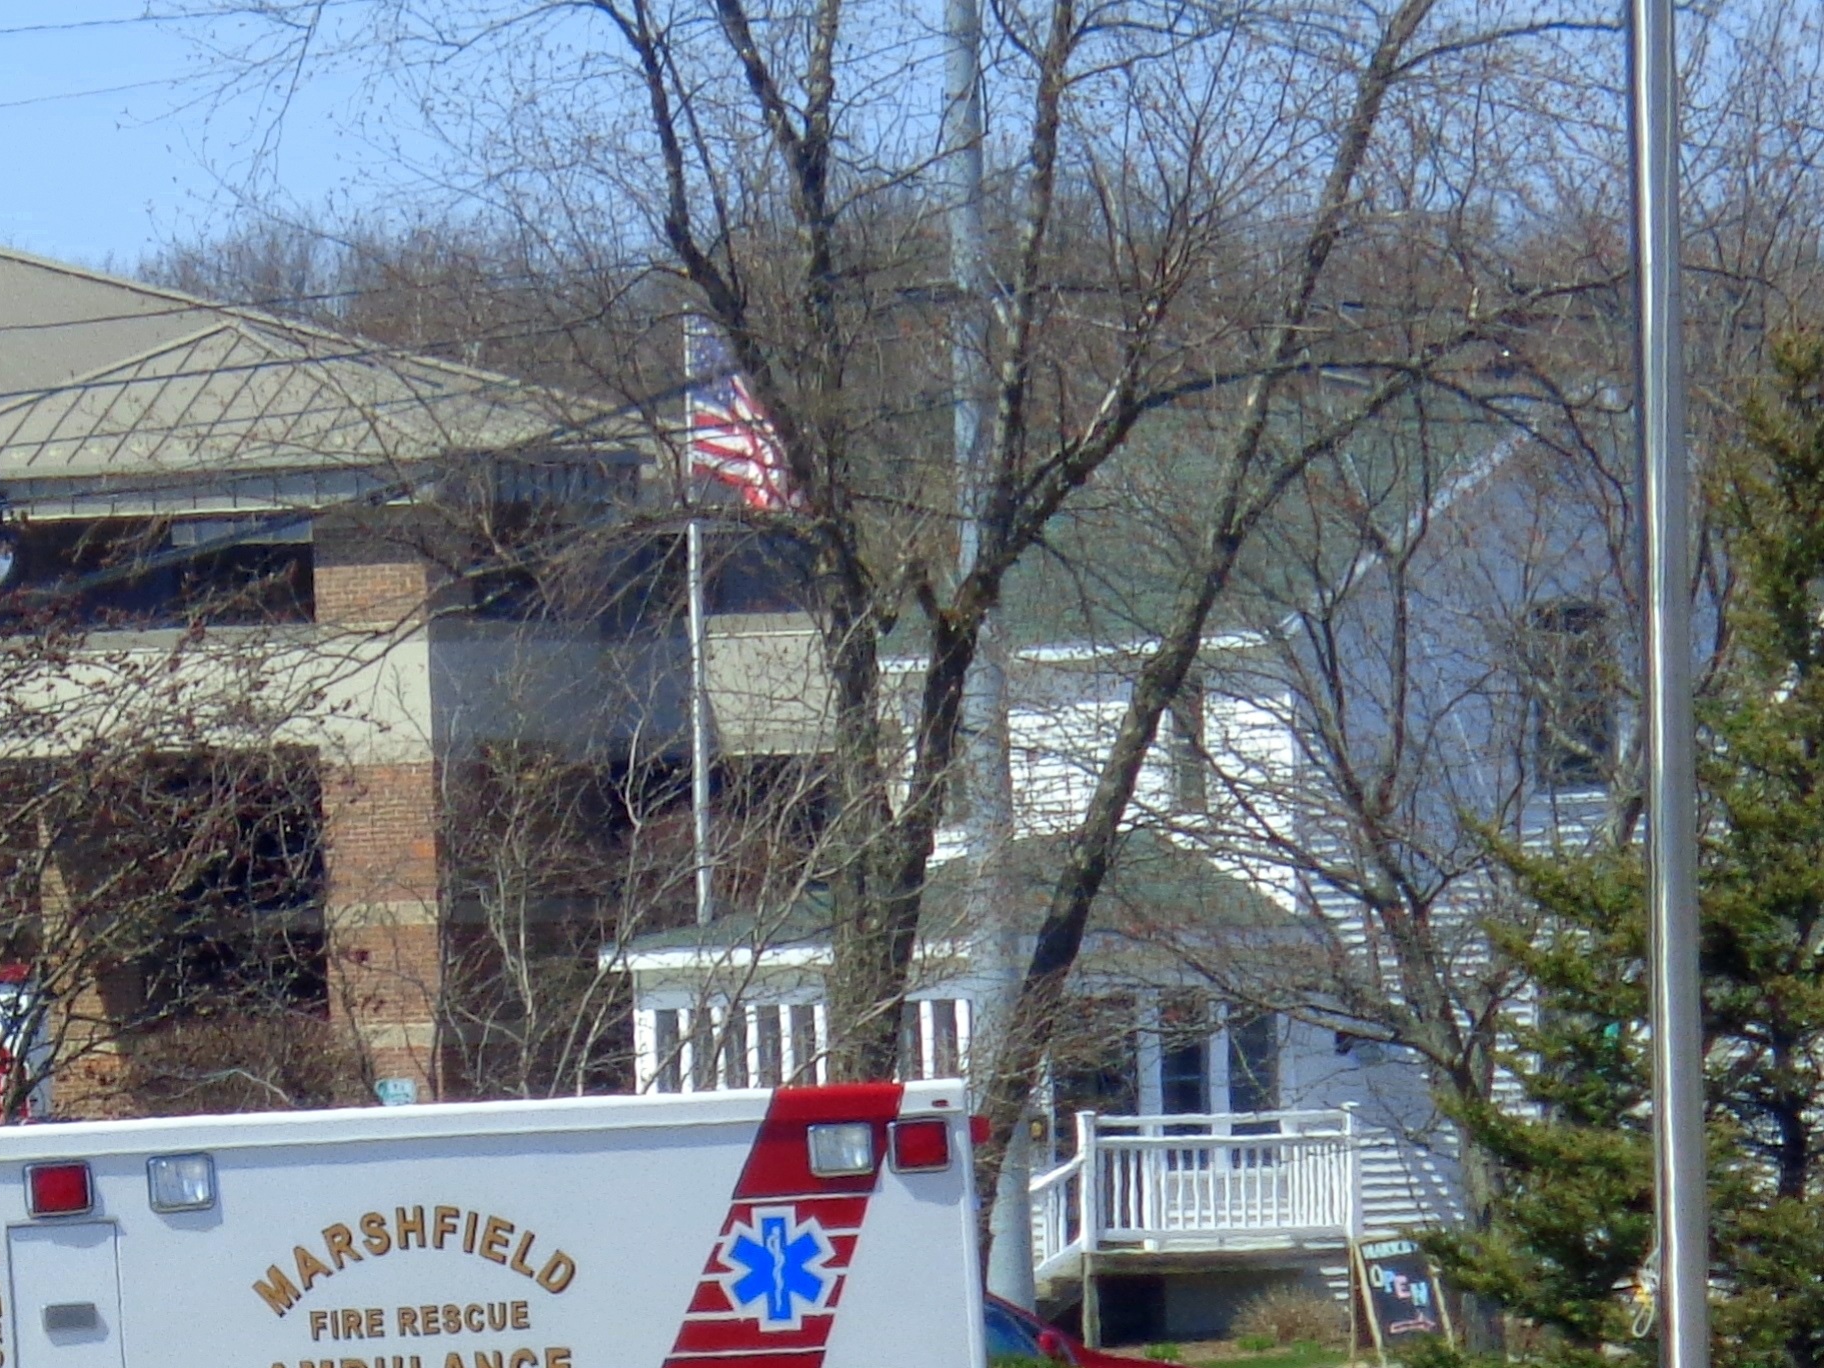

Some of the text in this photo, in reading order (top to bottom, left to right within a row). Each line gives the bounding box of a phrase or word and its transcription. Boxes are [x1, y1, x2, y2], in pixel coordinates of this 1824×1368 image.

[250, 1204, 577, 1318] MARSHFIELD
[1369, 1263, 1428, 1307] OPEN
[308, 1299, 531, 1343] FIRE RESCUE
